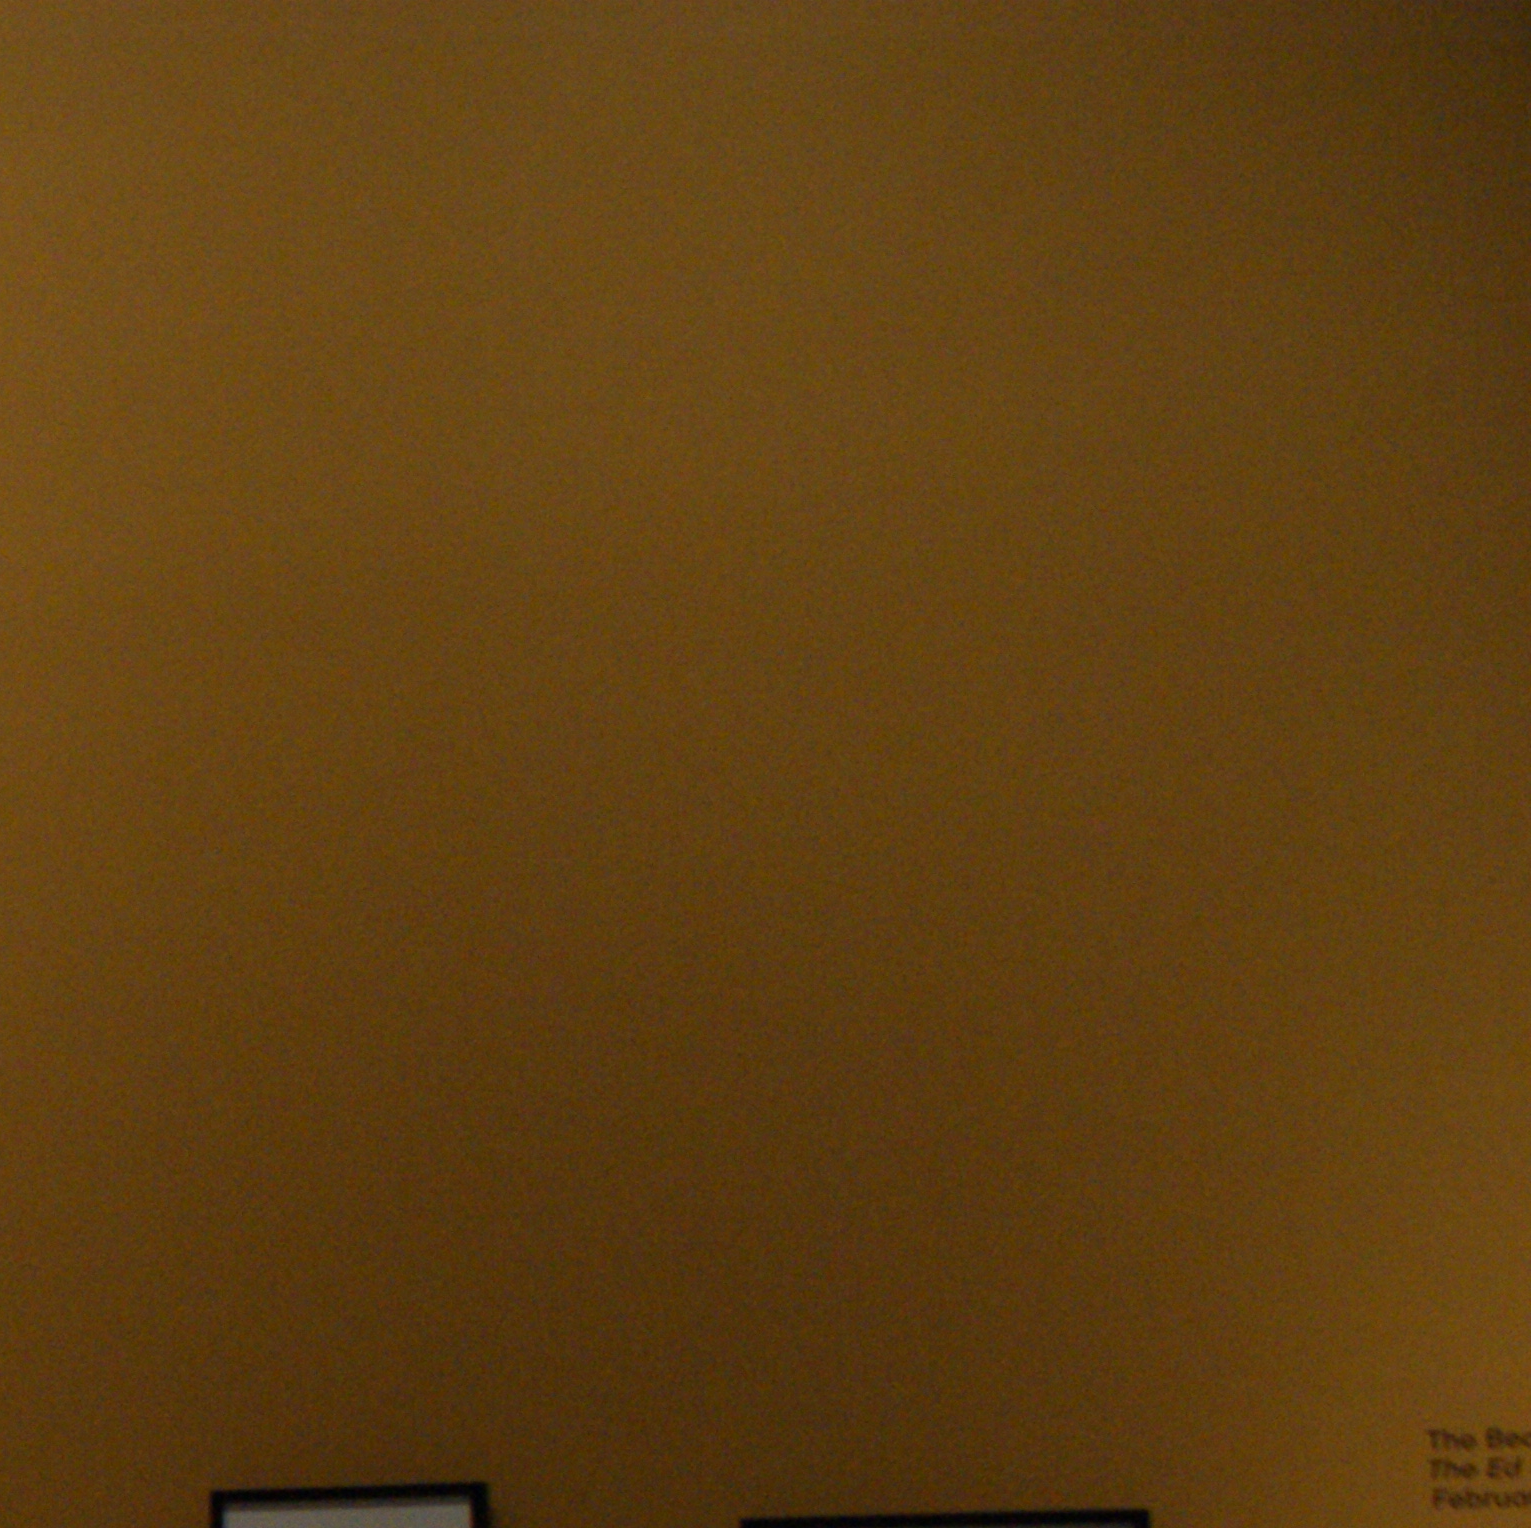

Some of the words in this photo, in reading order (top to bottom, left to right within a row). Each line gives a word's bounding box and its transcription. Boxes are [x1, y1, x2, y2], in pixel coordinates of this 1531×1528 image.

[1425, 1427, 1477, 1452] The
[1427, 1456, 1478, 1480] The
[1486, 1455, 1524, 1480] Ed
